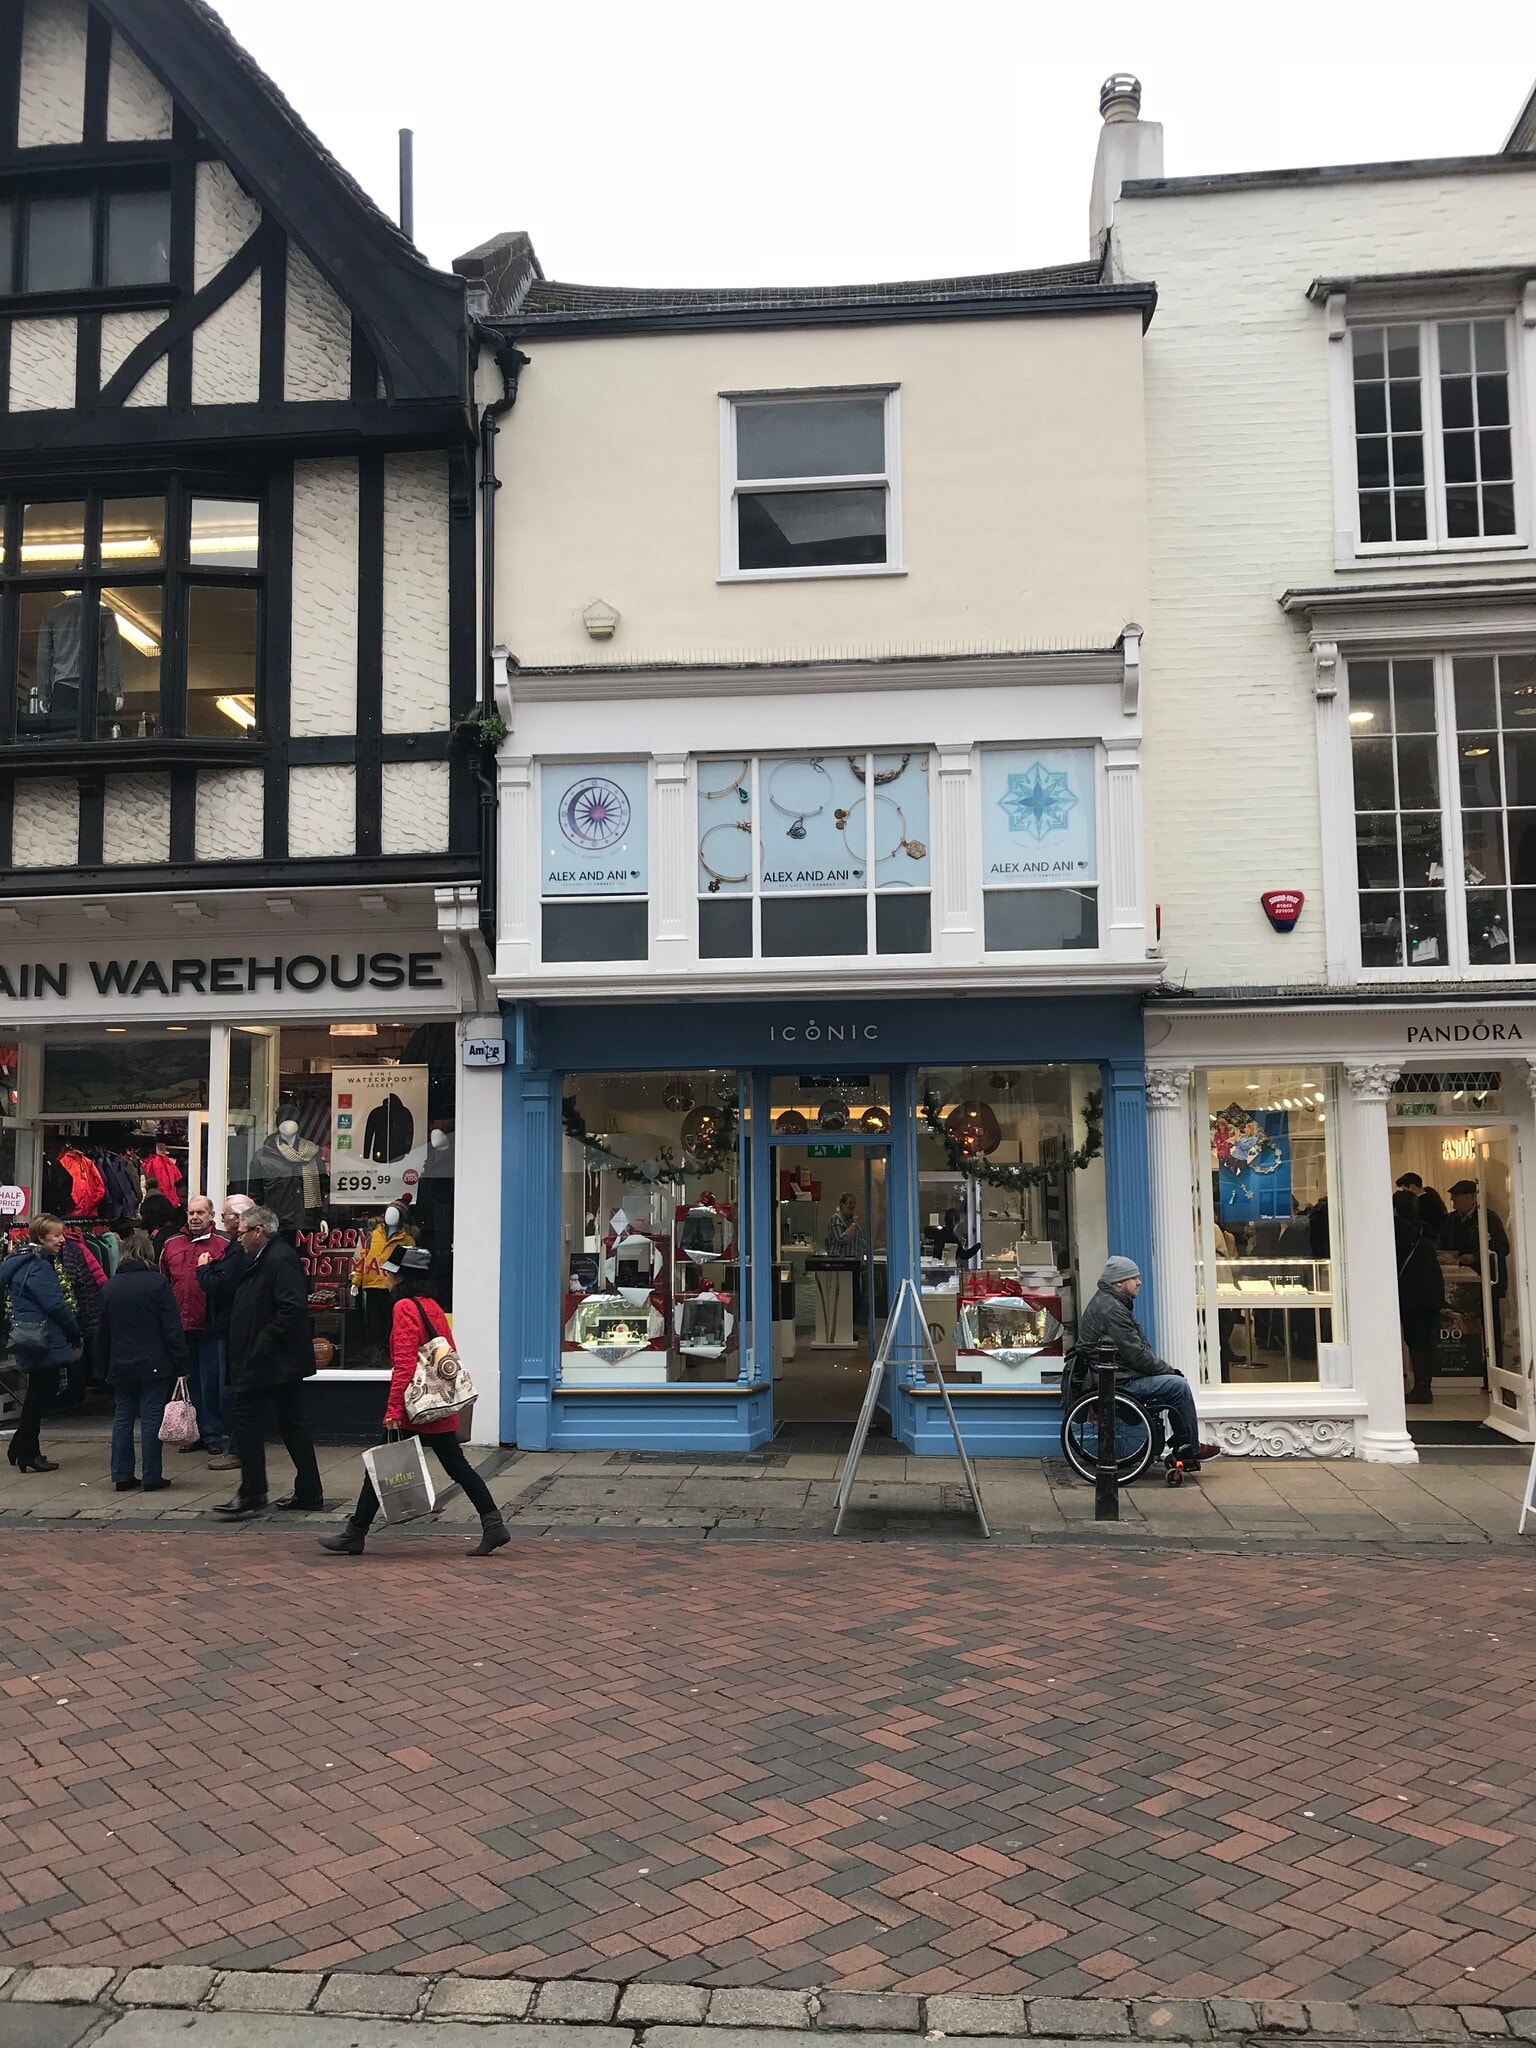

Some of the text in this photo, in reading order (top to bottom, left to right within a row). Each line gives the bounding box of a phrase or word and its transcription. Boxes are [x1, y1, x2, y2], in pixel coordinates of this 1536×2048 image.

[990, 860, 1074, 873] ALEX AND ANI
[548, 869, 627, 882] ALEX AND ANI
[763, 869, 849, 882] ALEX AND ANI
[89, 952, 443, 995] WAREHOUSE
[769, 1020, 878, 1041] ICONIC
[1407, 1022, 1523, 1042] PANDORA
[347, 1076, 414, 1084] WATERPROOF
[91, 1102, 202, 1110] www.mountainwarehouse.com
[337, 1175, 391, 1191] £99.99
[295, 1228, 372, 1257] MERRY
[1440, 1328, 1462, 1340] DO
